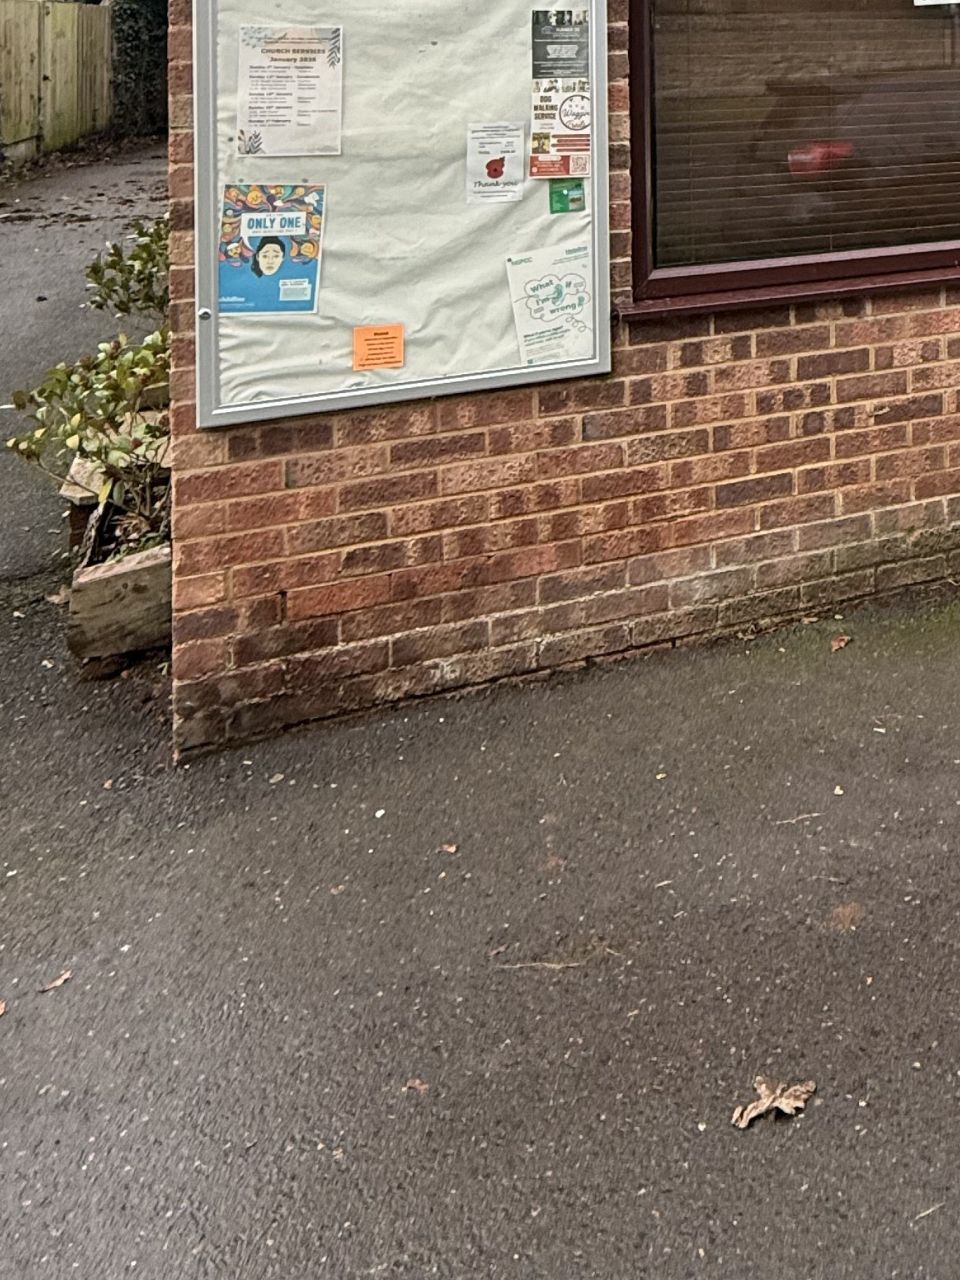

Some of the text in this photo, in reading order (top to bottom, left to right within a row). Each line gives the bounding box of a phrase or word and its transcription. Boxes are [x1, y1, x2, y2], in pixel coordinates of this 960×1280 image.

[247, 217, 301, 229] ONLY ONE
[530, 280, 554, 293] What
[549, 304, 577, 314] wrong
